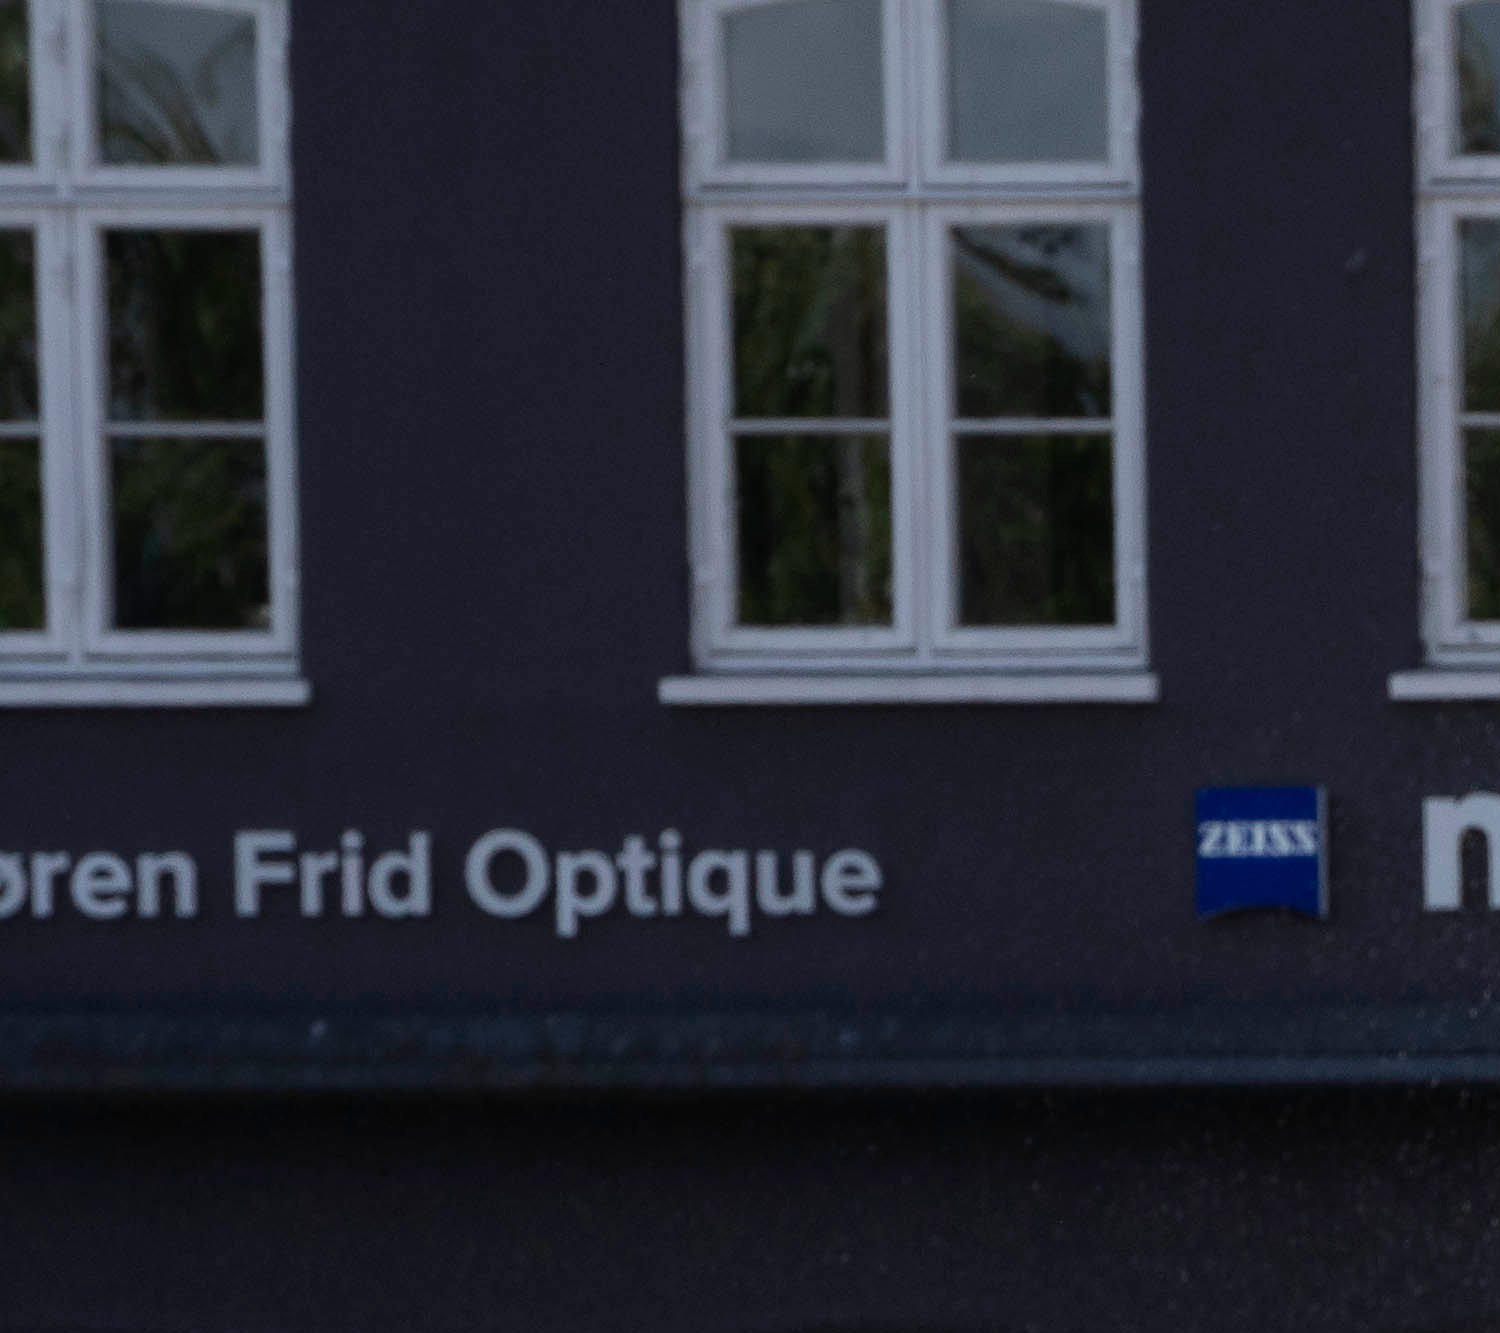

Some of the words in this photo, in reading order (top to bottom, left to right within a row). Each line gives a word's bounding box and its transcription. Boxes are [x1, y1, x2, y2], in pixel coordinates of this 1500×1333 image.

[1198, 820, 1317, 858] ZEISS
[233, 829, 431, 917] Frid
[464, 828, 882, 937] Optique
